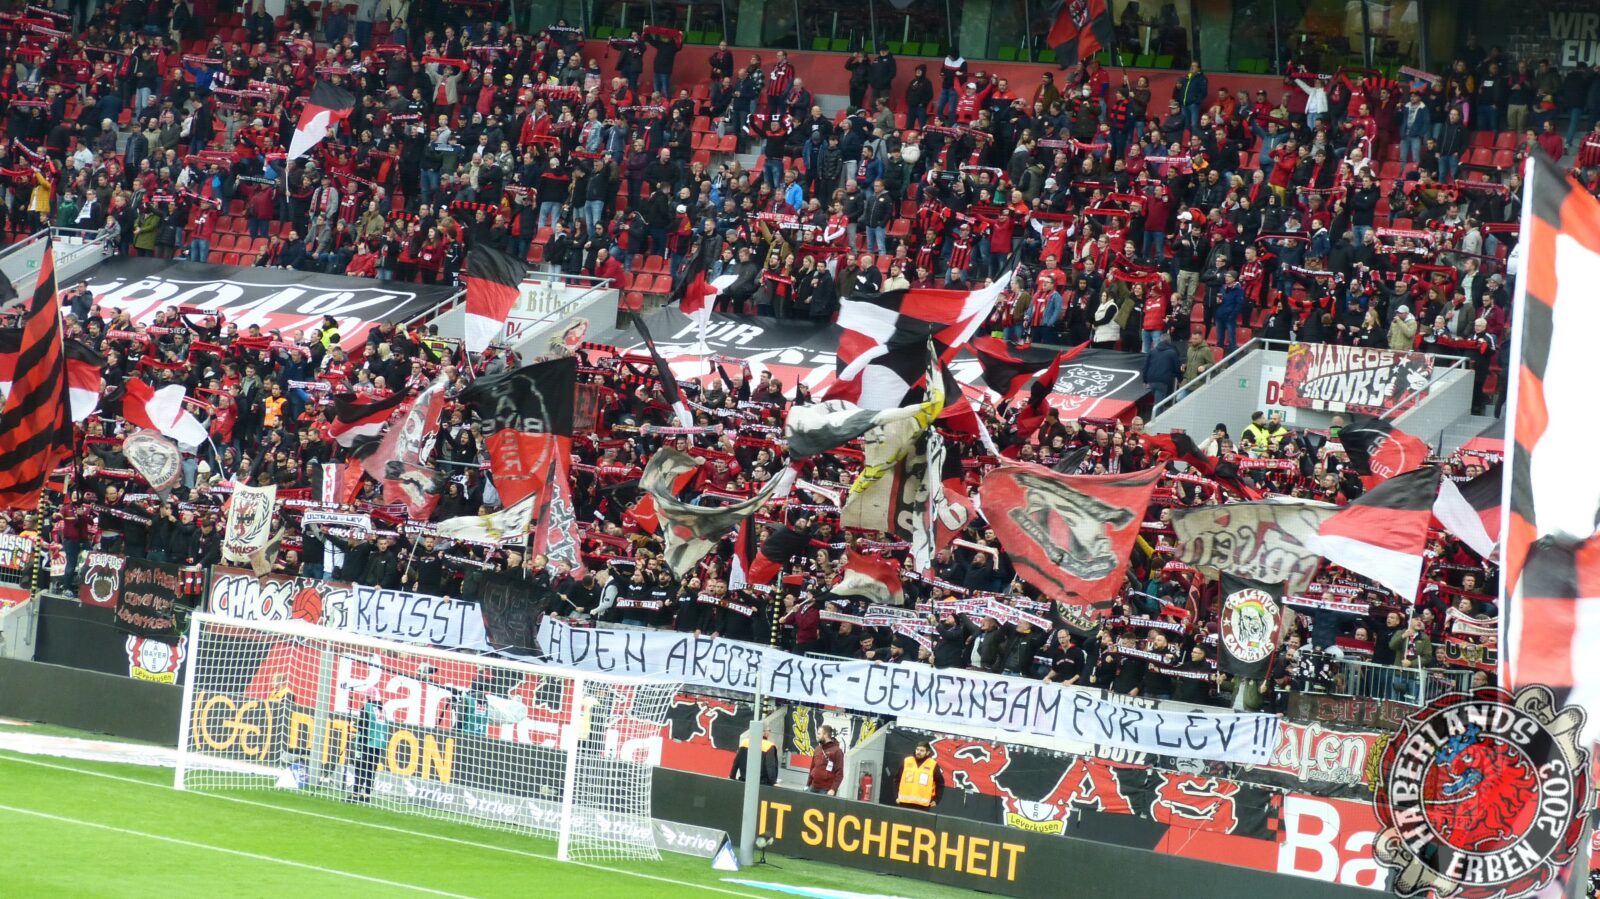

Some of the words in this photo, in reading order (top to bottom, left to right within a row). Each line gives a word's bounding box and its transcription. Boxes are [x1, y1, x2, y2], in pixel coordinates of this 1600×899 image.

[1303, 367, 1391, 407] SKUNKS
[306, 514, 338, 522] ULTRAS
[345, 515, 363, 524] LEV
[212, 575, 293, 622] CHAOS
[1225, 589, 1280, 615] COLLETIVO
[144, 649, 167, 659] BAYER
[134, 668, 172, 684] Leverkusen
[356, 587, 478, 645] REISST
[569, 625, 647, 674] DEN
[666, 637, 763, 689] ARSCH
[863, 664, 1063, 736] GEMEINSAM
[1156, 696, 1241, 753] LEV
[1010, 815, 1060, 833] Leverkusen
[677, 832, 717, 852] trive
[801, 808, 1026, 881] SICHERHEIT
